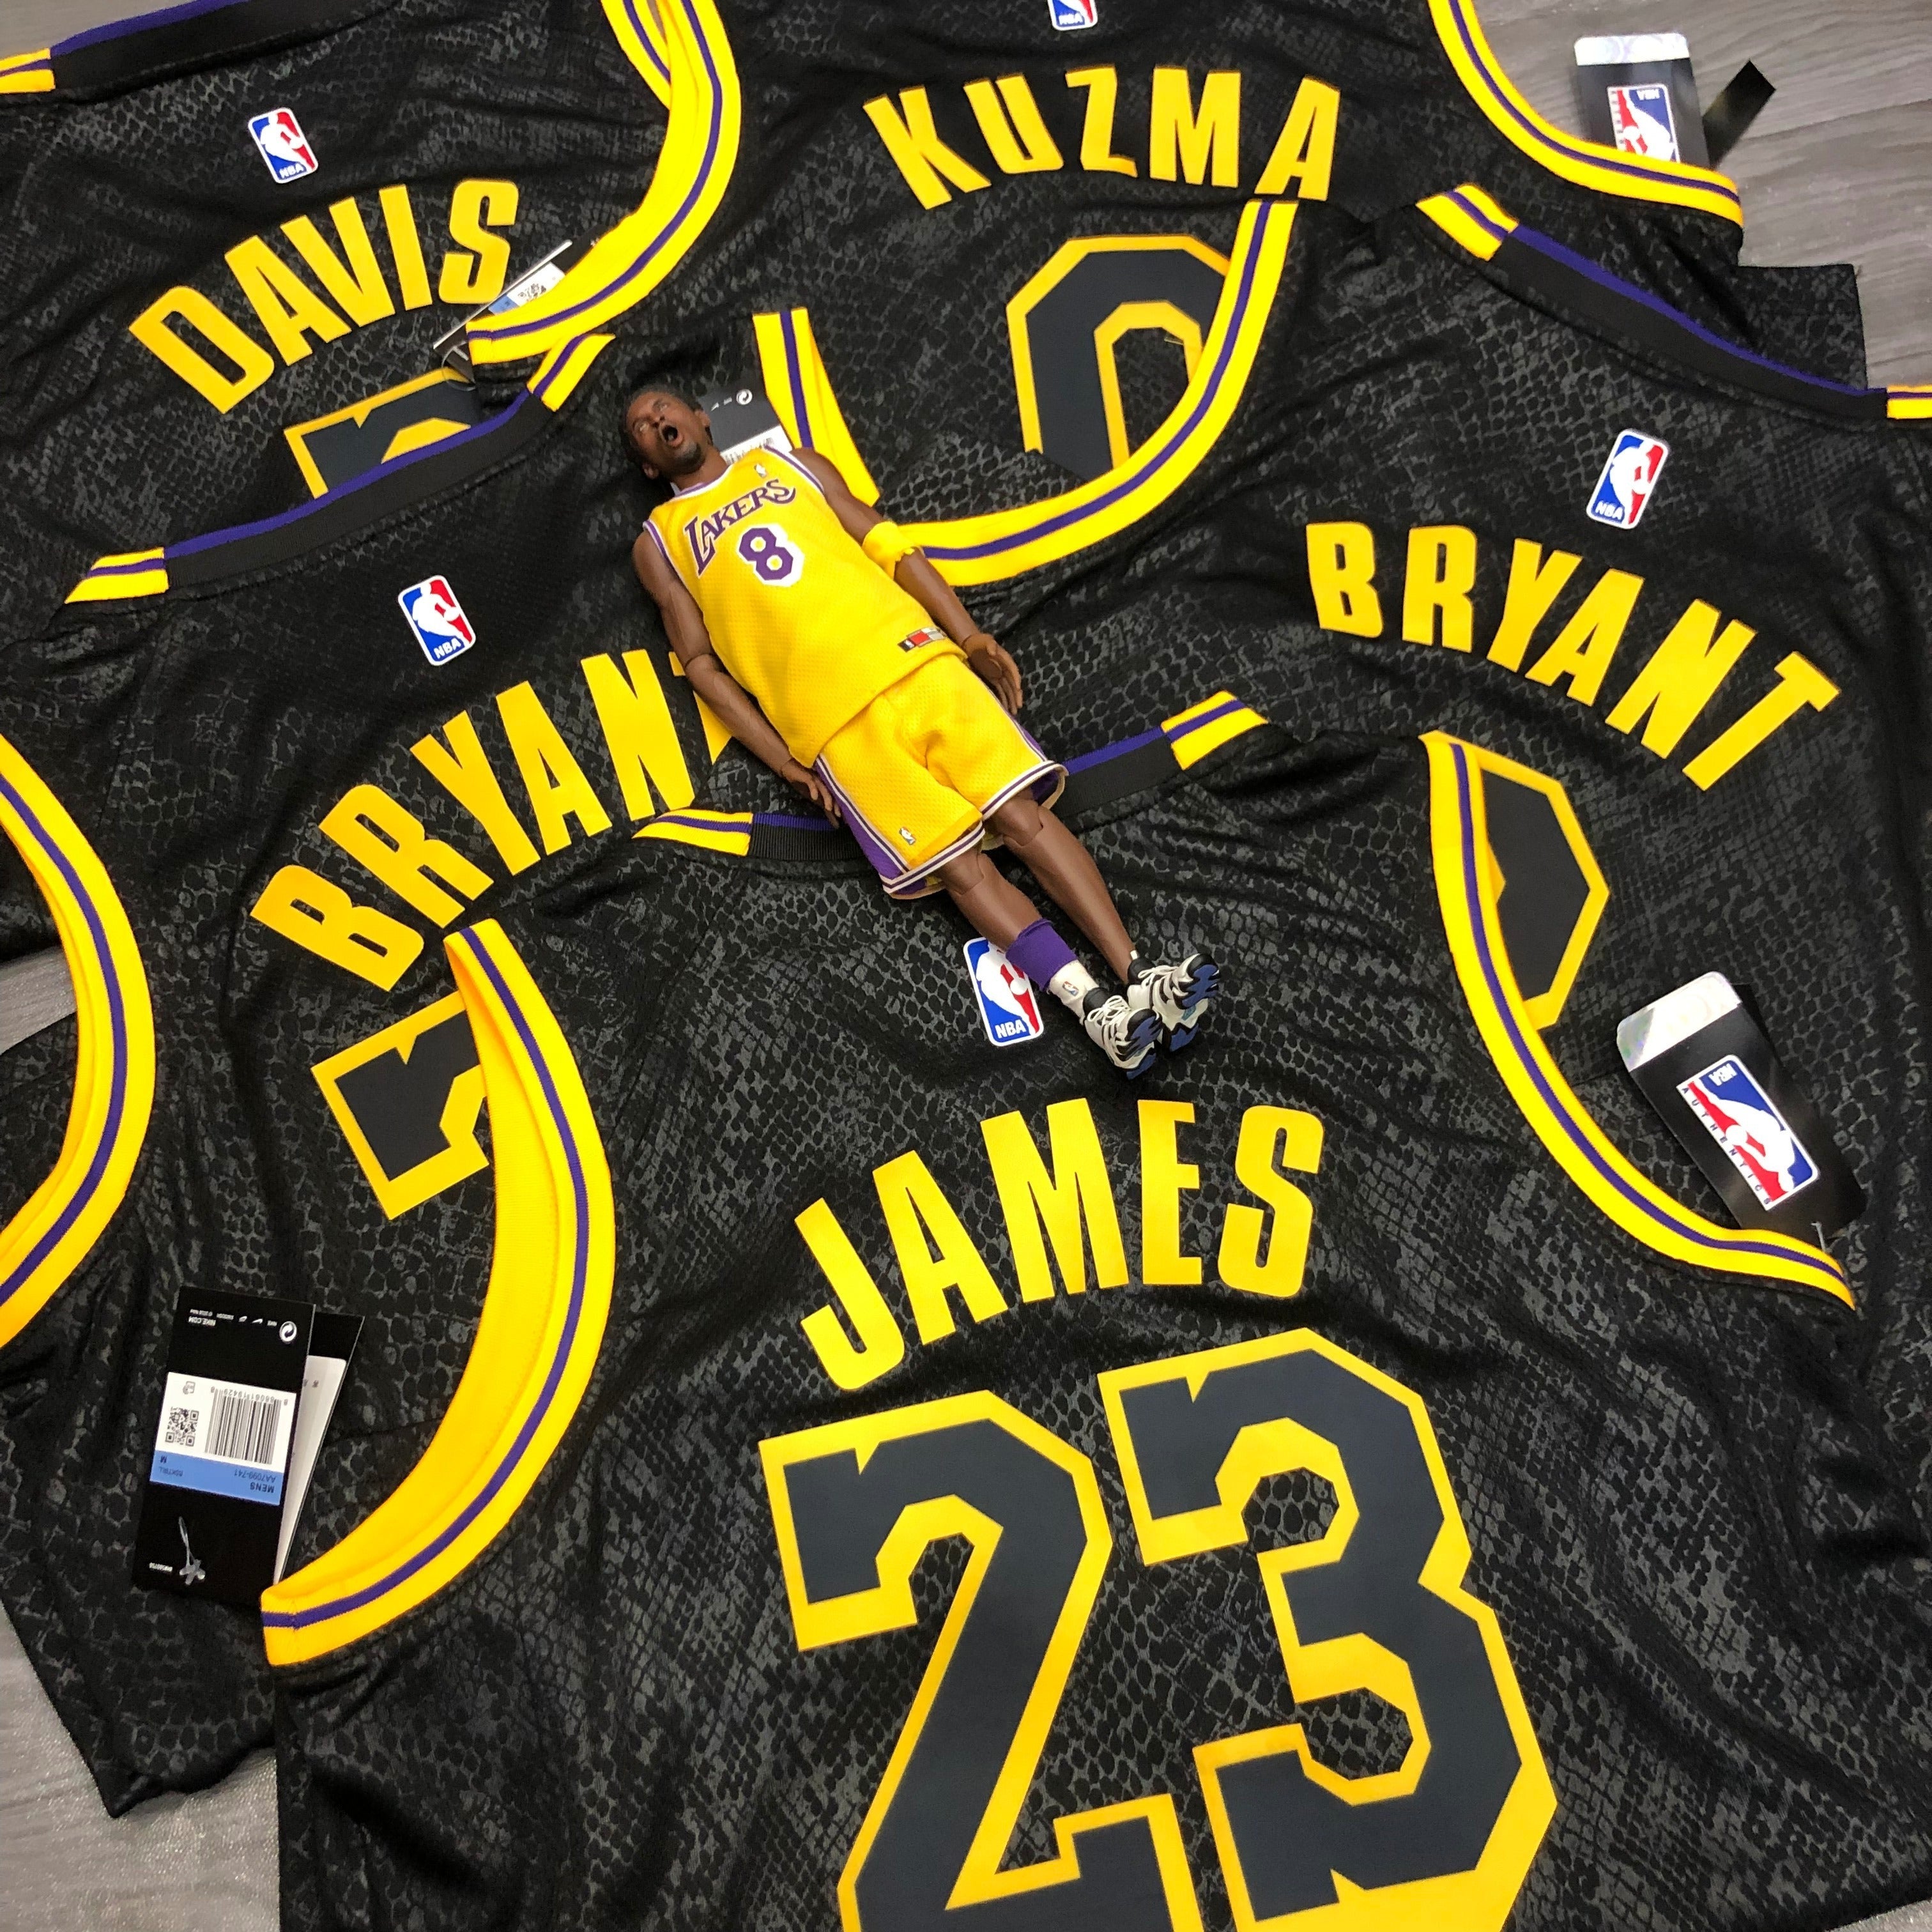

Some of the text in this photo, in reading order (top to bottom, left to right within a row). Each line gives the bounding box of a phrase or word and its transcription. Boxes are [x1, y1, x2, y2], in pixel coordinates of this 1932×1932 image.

[1059, 12, 1084, 25] NBA
[862, 63, 1340, 210] KUZMA
[279, 163, 304, 179] NBA
[129, 179, 519, 414] DAVIS
[683, 478, 797, 578] LAKERS
[1595, 500, 1623, 520] NBA
[735, 523, 805, 587] 8
[433, 638, 461, 659] NBA
[1305, 521, 1841, 791] BRYANT
[995, 1019, 1027, 1039] NBA
[1708, 1062, 1738, 1087] NBA
[1682, 1087, 1772, 1206] AUTHENTICS
[793, 1098, 1324, 1390] JAMES
[250, 1482, 275, 1494] MENS
[758, 1327, 1558, 1932] 23
